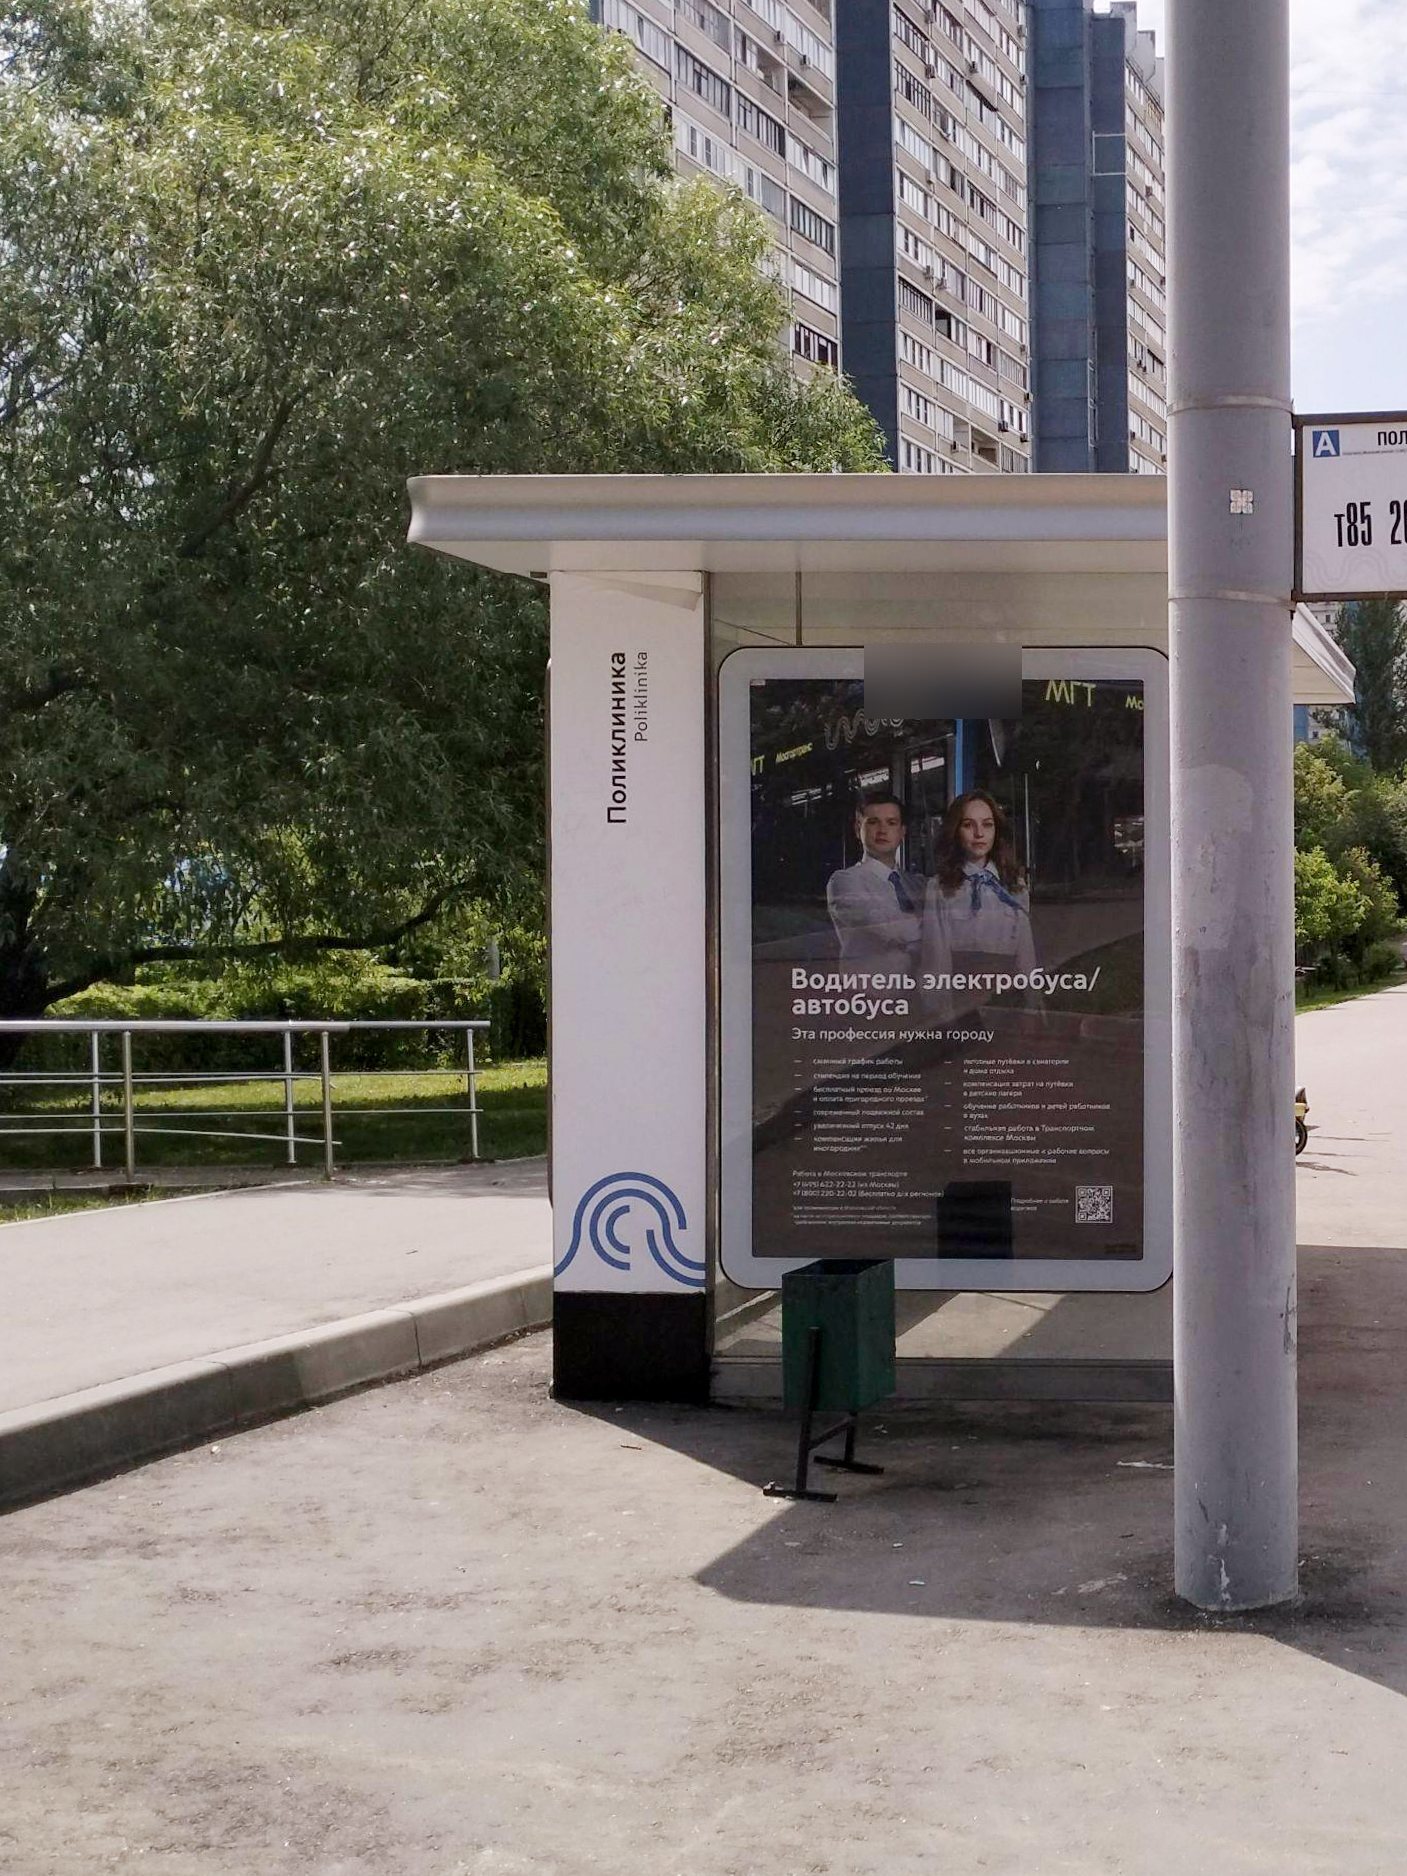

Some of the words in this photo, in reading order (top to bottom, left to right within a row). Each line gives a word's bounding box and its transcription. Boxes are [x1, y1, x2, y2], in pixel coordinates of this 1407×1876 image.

[633, 651, 648, 742] Poliklinika
[607, 652, 627, 824] Поликлиника
[791, 968, 916, 993] Водитель
[923, 966, 1101, 994] электробуса/
[791, 993, 909, 1020] автобуса
[792, 1028, 815, 1040] Эта
[819, 1027, 895, 1042] профессия
[900, 1029, 942, 1041] нужна
[947, 1029, 995, 1043] городу
